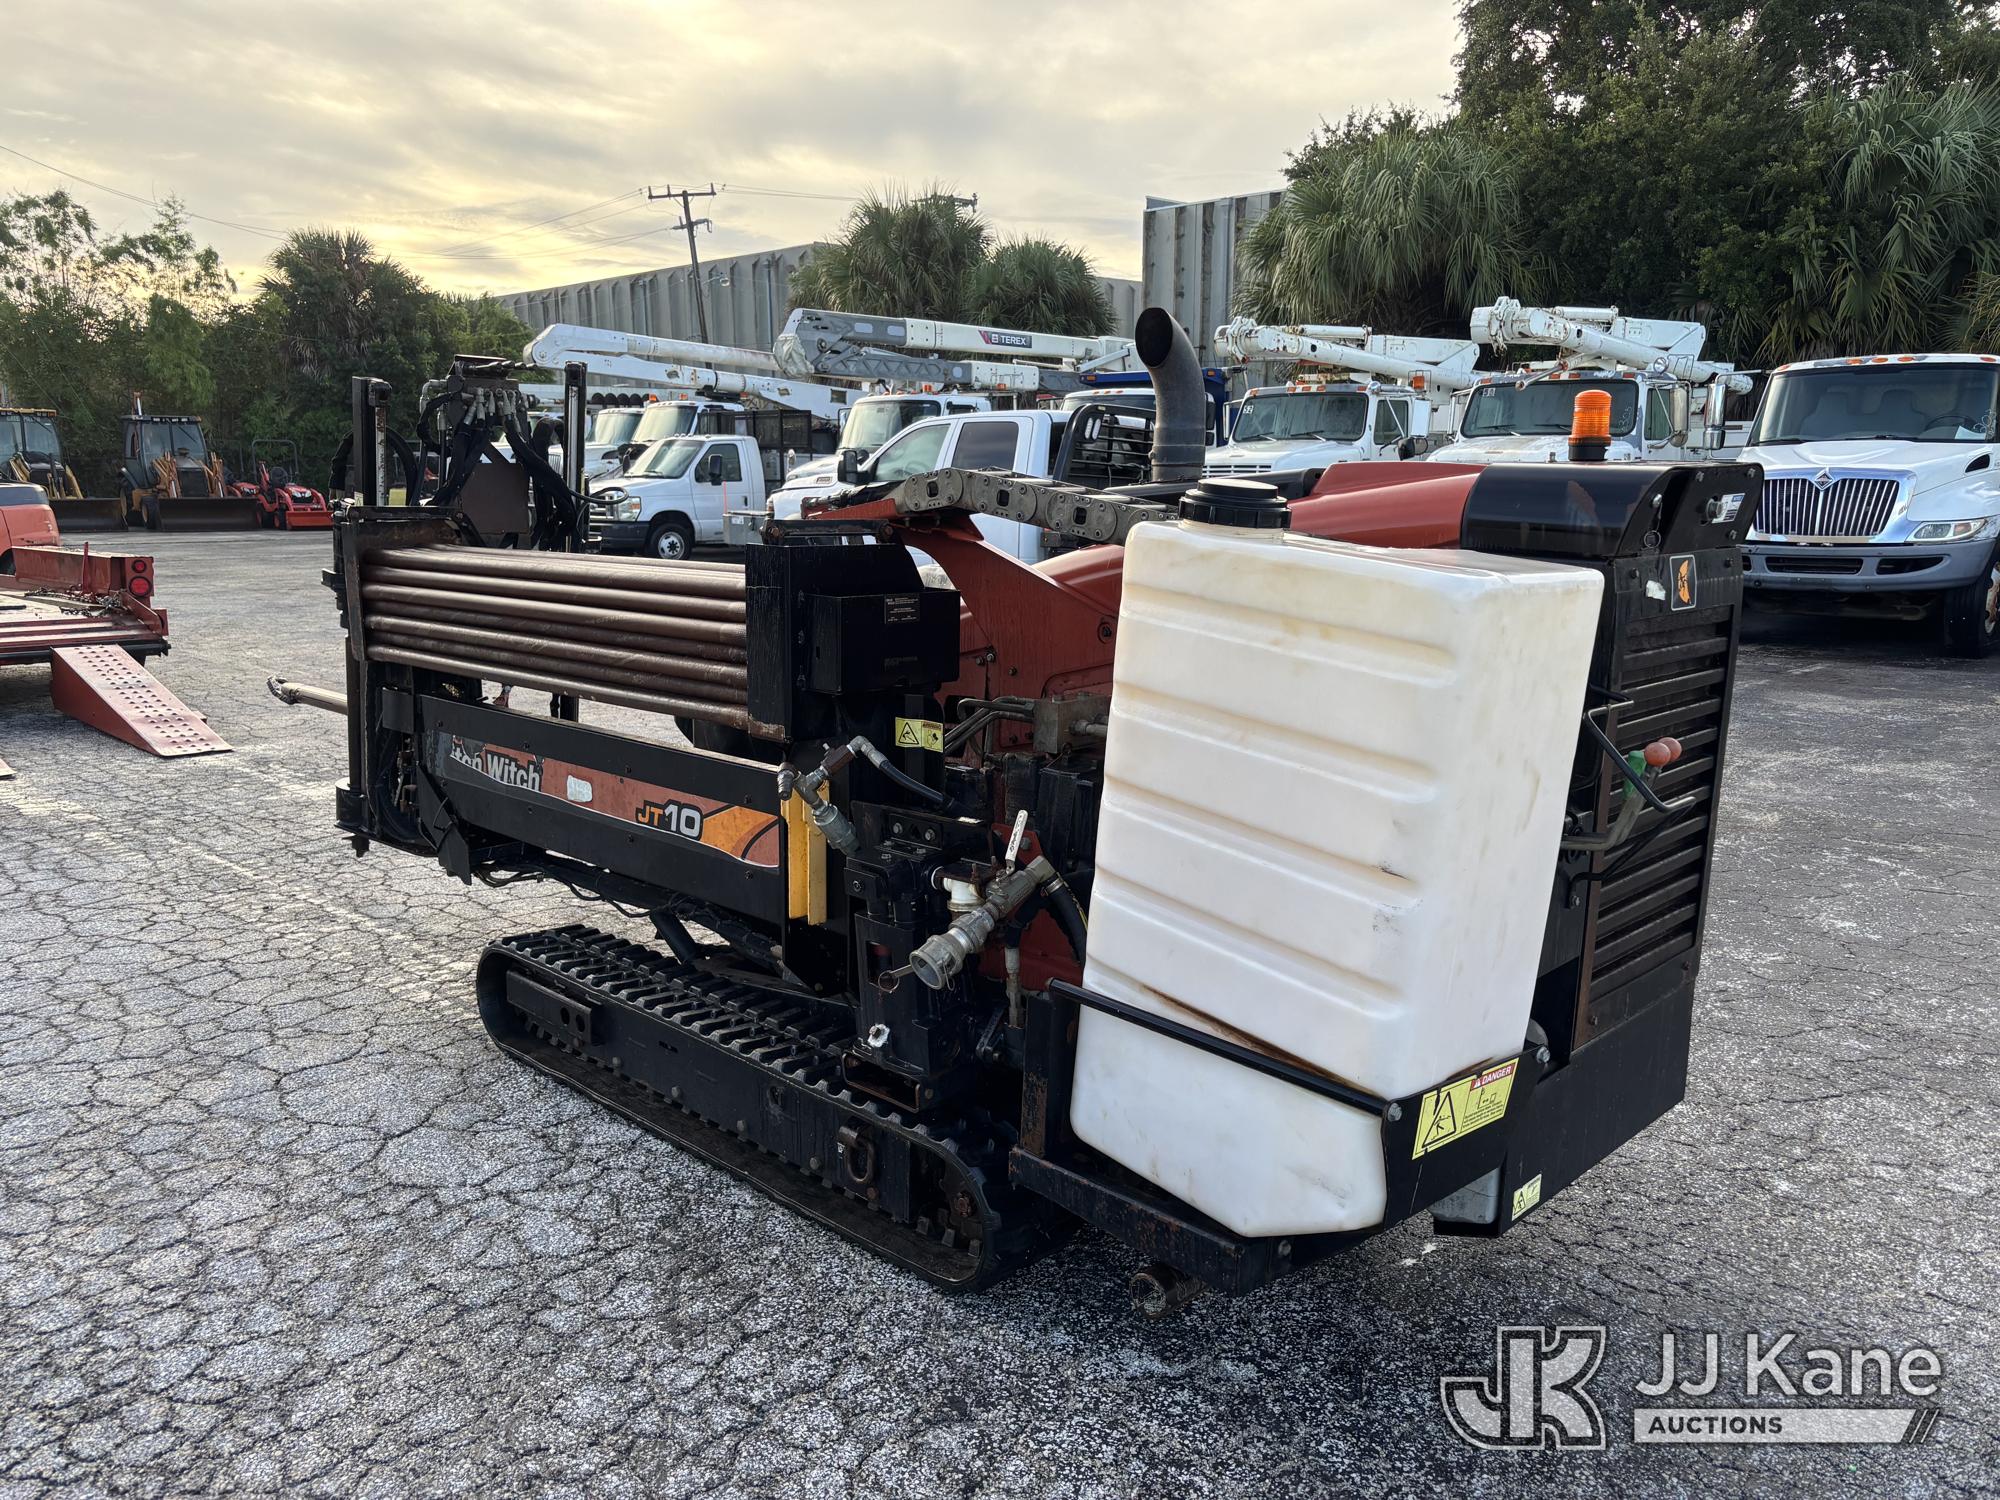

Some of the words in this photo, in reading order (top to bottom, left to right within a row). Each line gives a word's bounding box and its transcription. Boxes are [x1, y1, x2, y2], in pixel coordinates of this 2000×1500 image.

[1000, 335, 1027, 346] TEREX
[487, 753, 540, 791] Witch
[1481, 1065, 1513, 1086] DANGER
